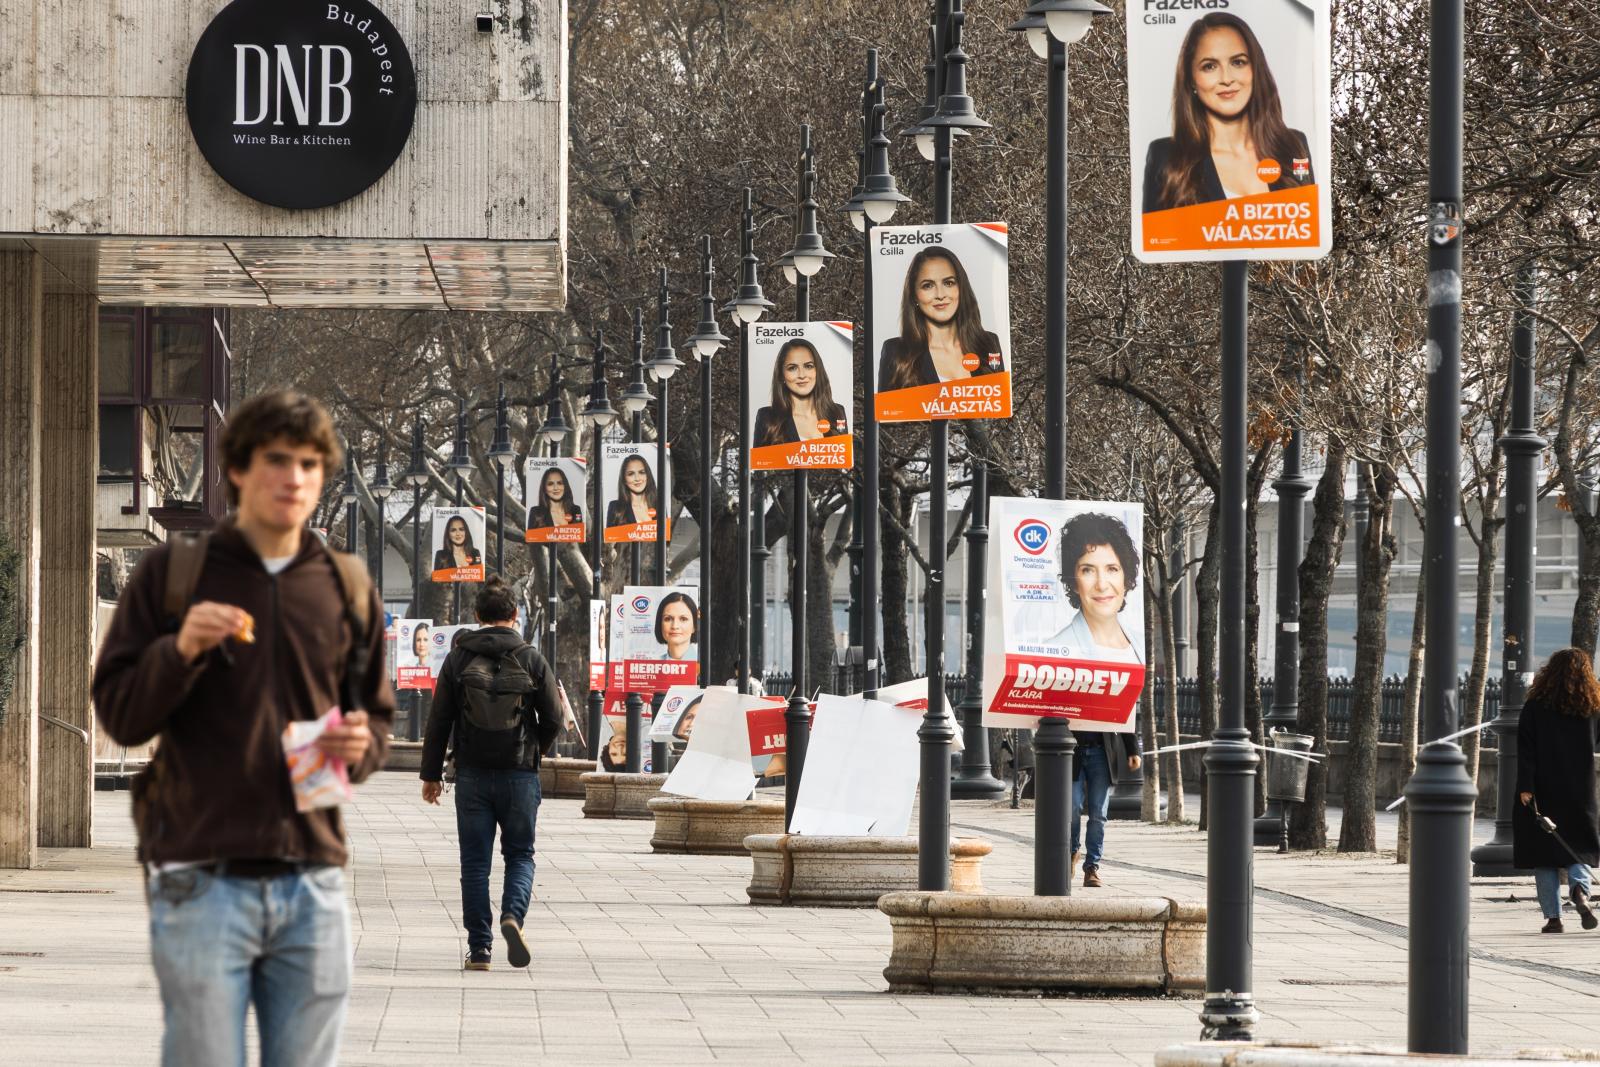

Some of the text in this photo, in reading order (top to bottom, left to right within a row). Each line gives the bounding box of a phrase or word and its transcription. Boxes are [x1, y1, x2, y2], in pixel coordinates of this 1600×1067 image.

[1143, 13, 1176, 25] Csilla
[326, 3, 394, 96] Budapest
[233, 43, 352, 127] DNB
[233, 134, 266, 145] Wine
[270, 134, 291, 145] Bar
[302, 135, 352, 146] Kitchen
[1225, 203, 1311, 221] A BIZTOS
[1201, 220, 1311, 242] VÁLASZTÁS
[880, 229, 943, 246] Fazekas
[880, 246, 904, 256] Csilla
[755, 325, 805, 337] Fazekas
[755, 337, 775, 345] Csilla
[939, 384, 1002, 398] A BIZTOS
[921, 398, 1002, 414] VÁLASZTÁS
[606, 446, 639, 454] Fazekas
[799, 443, 846, 453] A BIZTOS
[529, 459, 558, 467] Fazekas
[785, 453, 846, 465] VÁLASZTÁS
[546, 532, 581, 540] VÁLASZTÁS
[627, 530, 658, 539] VÁLASZT
[1025, 529, 1043, 543] dk
[400, 669, 429, 677] HERFORT
[629, 663, 689, 675] HERFORT
[1013, 662, 1131, 697] DOBREV
[1007, 688, 1043, 700] KLÁRA
